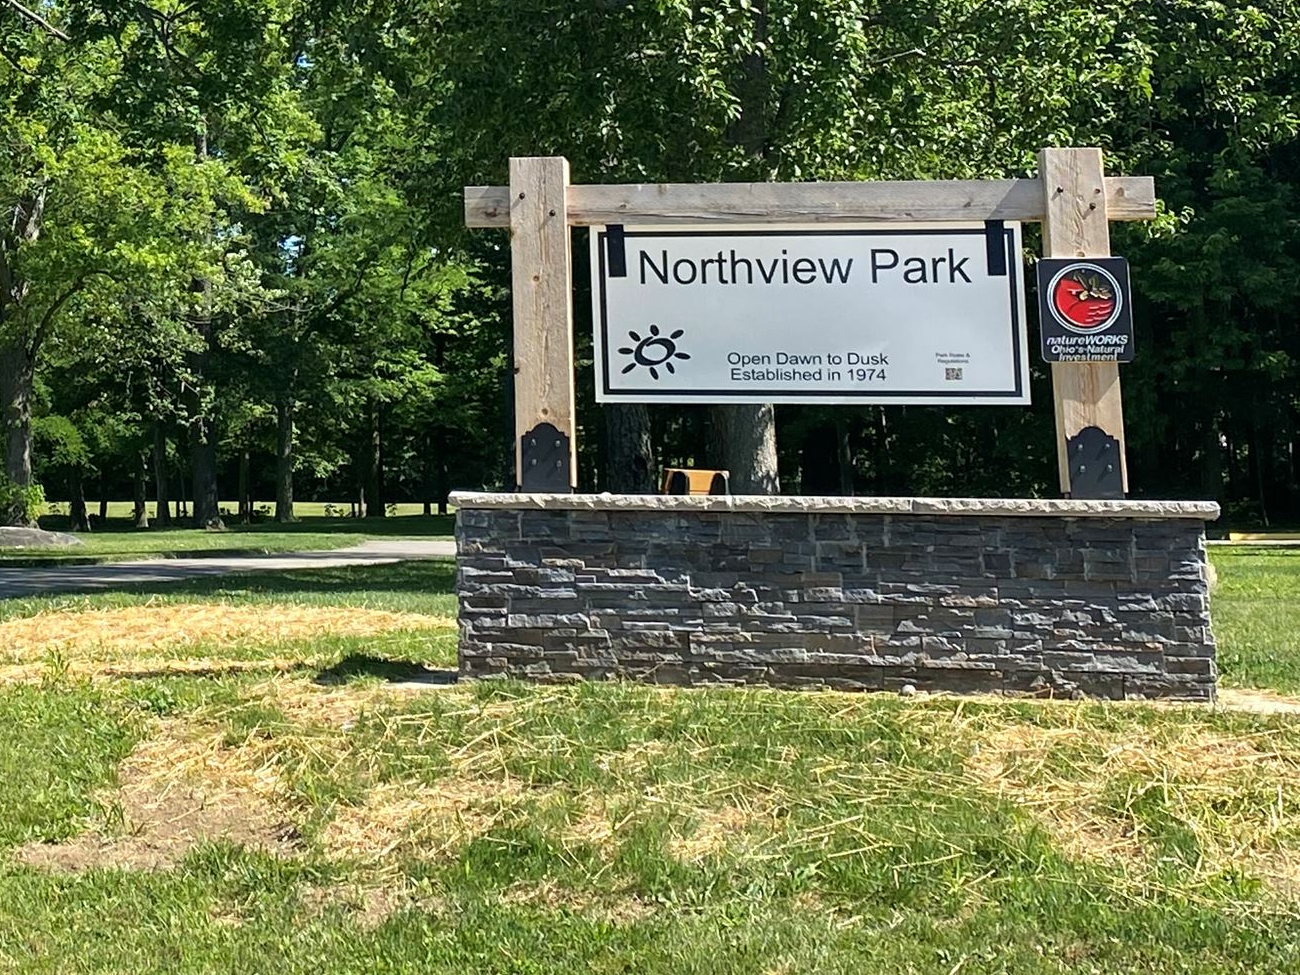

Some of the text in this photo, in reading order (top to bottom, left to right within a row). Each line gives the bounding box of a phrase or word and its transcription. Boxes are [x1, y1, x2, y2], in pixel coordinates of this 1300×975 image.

[639, 248, 972, 285] Northview Park
[1046, 335, 1128, 345] natureWORKS
[1086, 345, 1124, 353] Natural
[727, 352, 889, 367] Open Dawn to Dusk
[1059, 353, 1118, 361] Investment
[730, 368, 887, 381] Established in 1974
